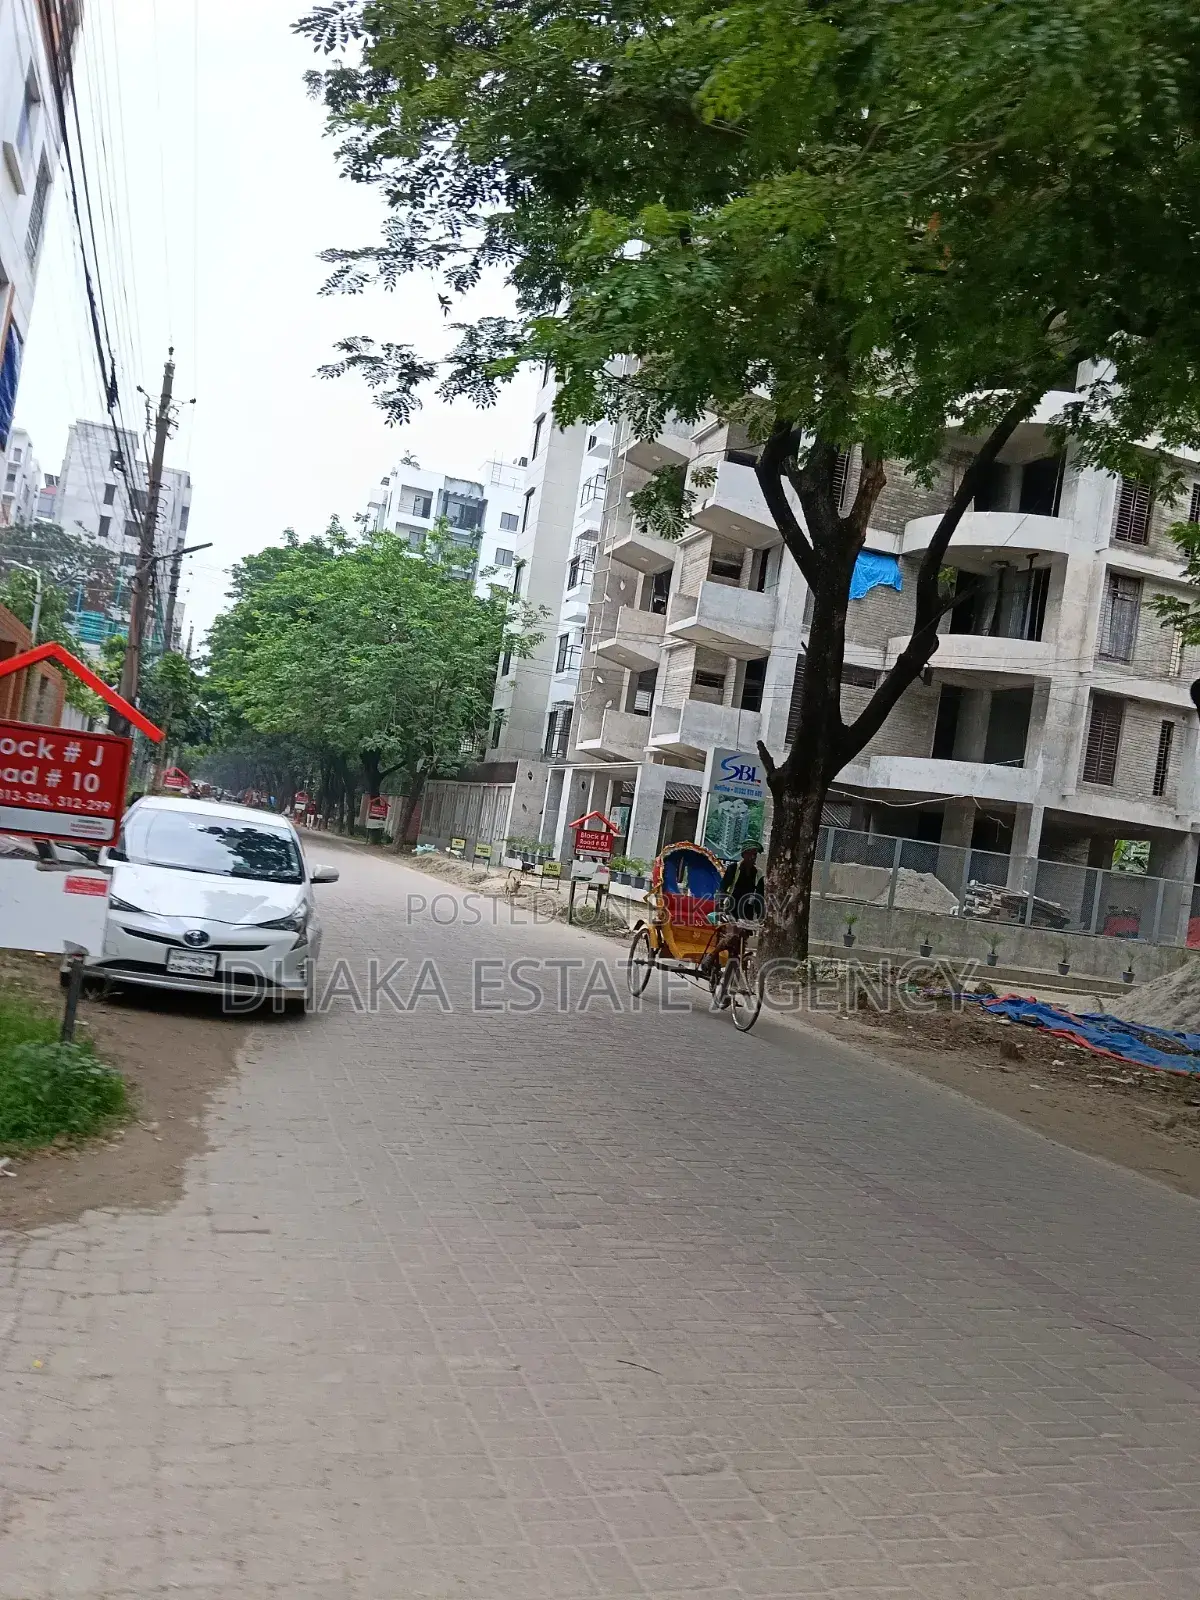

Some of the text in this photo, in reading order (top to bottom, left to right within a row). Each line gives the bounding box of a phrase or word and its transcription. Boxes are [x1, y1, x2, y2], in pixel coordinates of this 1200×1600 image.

[63, 741, 82, 763] #
[88, 745, 104, 767] J
[0, 765, 100, 793] ad # 10
